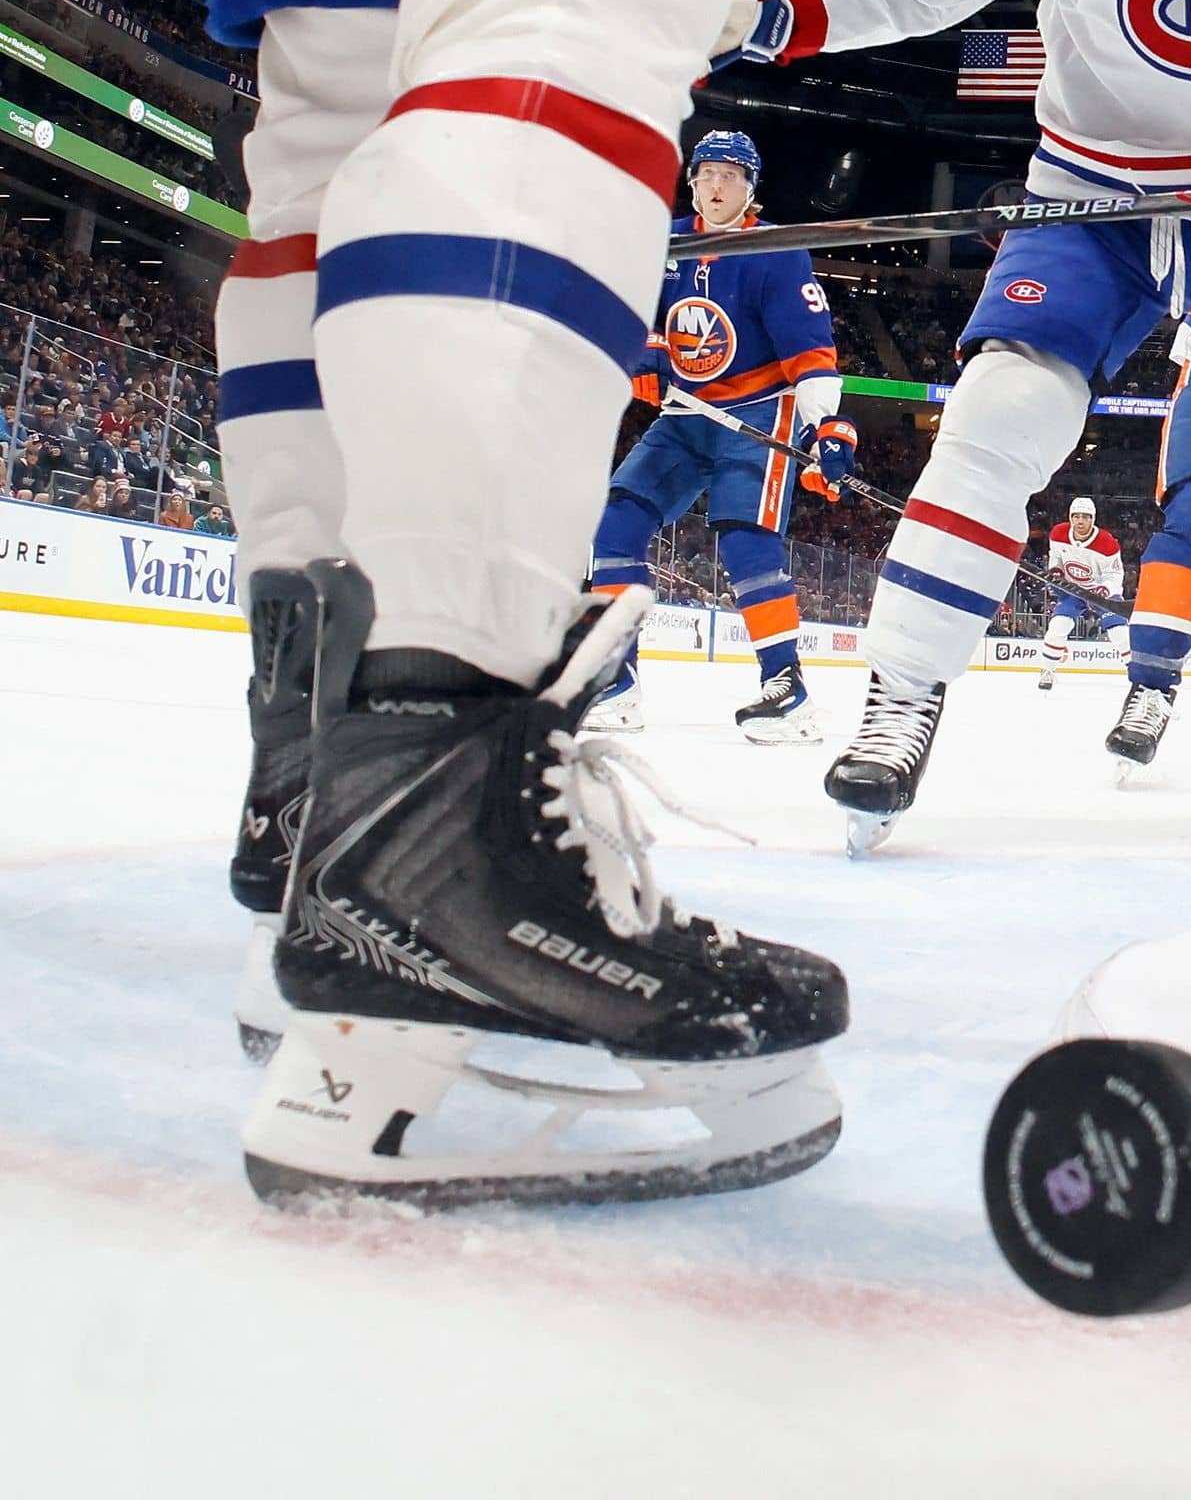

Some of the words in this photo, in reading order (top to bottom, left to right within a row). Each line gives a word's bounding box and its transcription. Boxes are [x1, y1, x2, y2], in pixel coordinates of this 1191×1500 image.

[107, 9, 149, 43] GORING
[229, 73, 252, 92] PAT
[1021, 195, 1135, 219] BAUER
[677, 306, 717, 334] NY
[1073, 649, 1120, 661] paylocit
[507, 919, 664, 1000] BAUER
